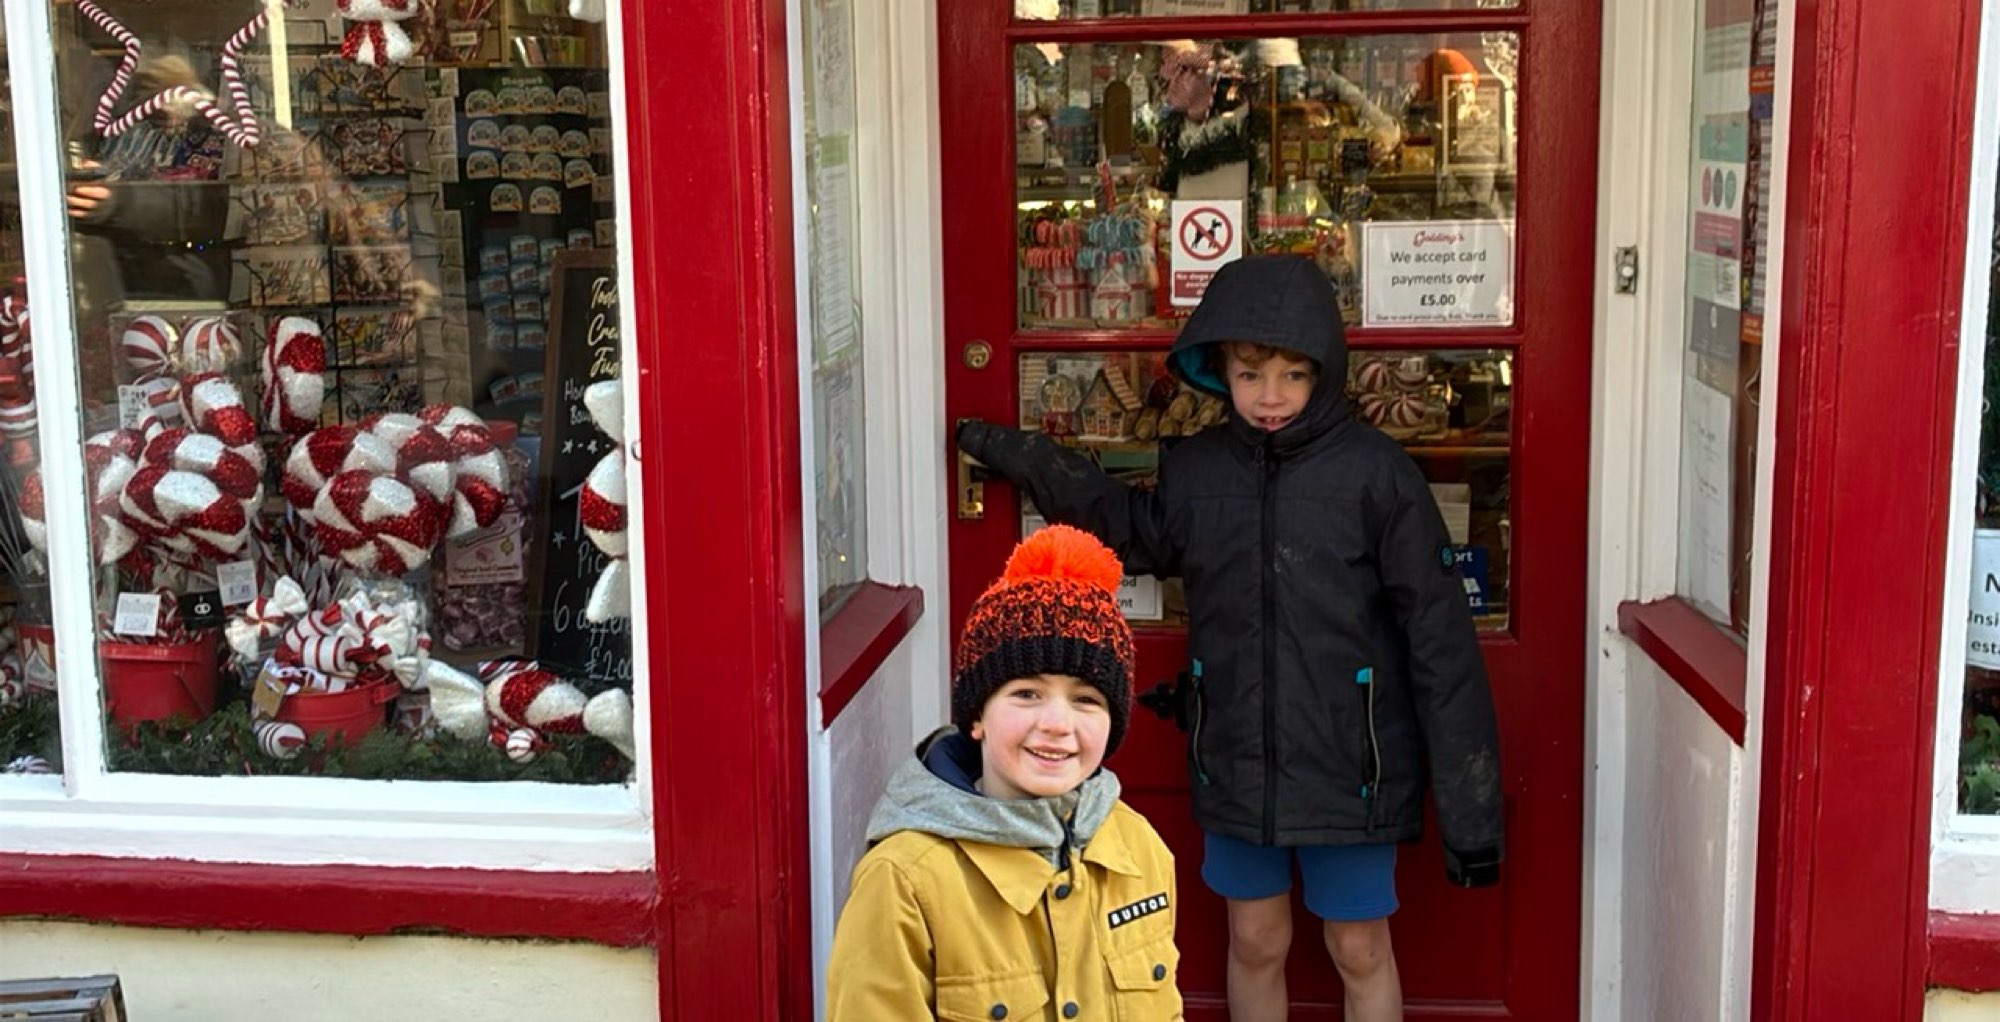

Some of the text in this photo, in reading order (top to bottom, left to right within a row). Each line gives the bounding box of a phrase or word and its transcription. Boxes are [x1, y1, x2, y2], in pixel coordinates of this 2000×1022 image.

[1390, 249, 1487, 265] We accept card
[1391, 273, 1486, 287] payments over
[1420, 294, 1456, 306] £5.00
[553, 580, 569, 632] 6
[1110, 895, 1167, 926] BURTON
